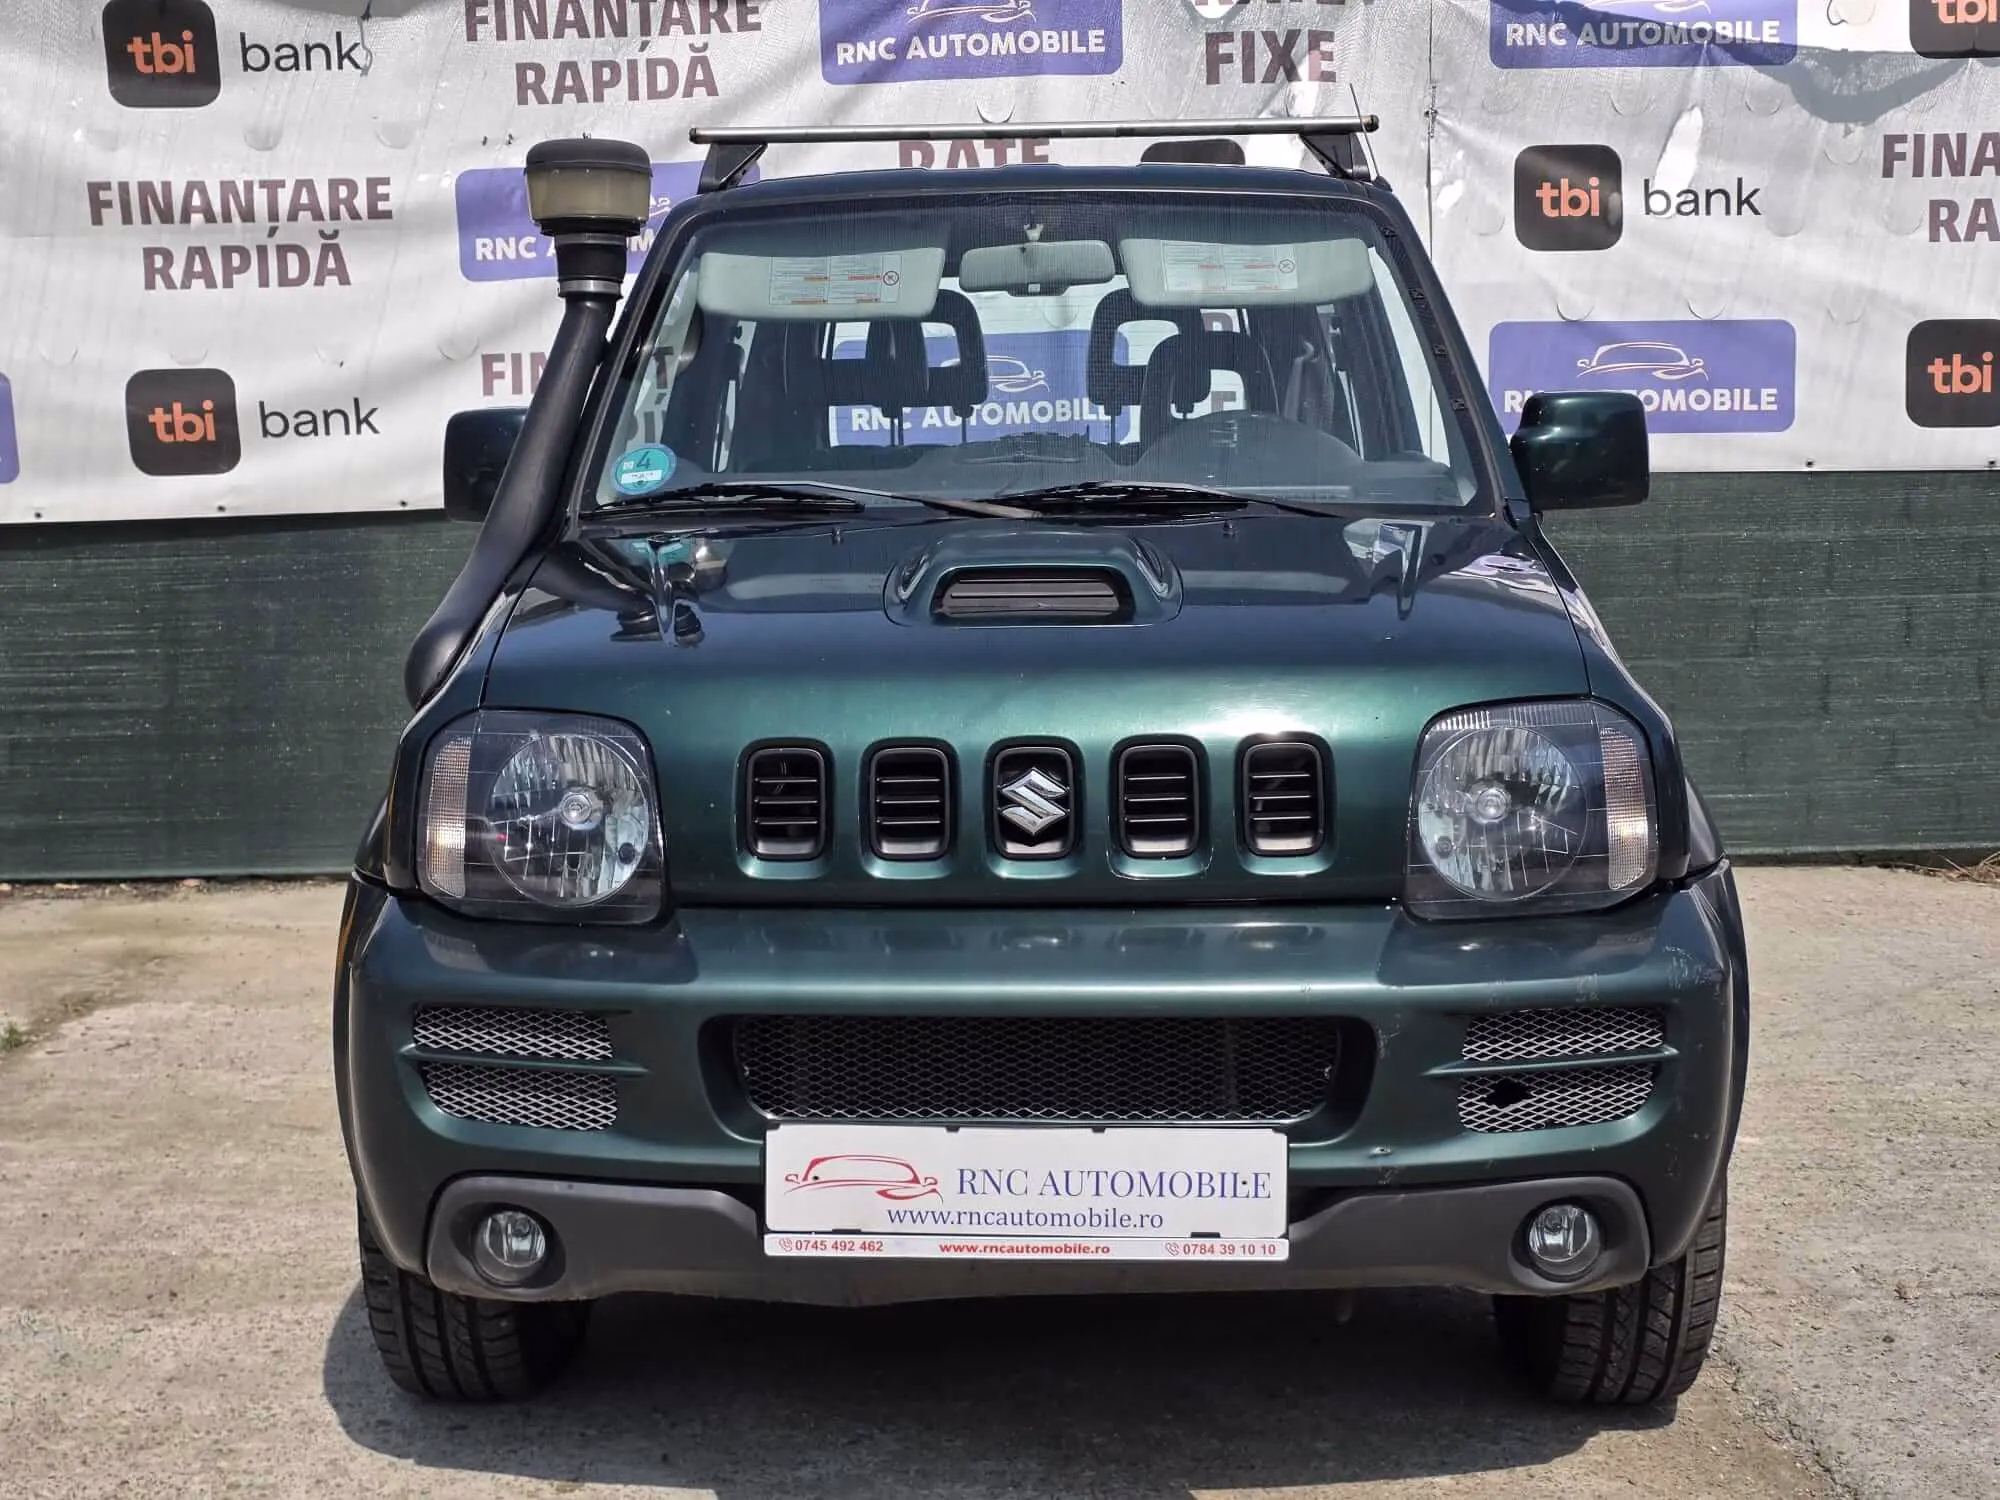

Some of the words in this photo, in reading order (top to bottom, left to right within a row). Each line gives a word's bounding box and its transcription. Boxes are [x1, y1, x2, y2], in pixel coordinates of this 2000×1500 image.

[836, 36, 897, 65] RNC
[905, 29, 1106, 59] AUTOMOBILE
[1505, 22, 1568, 46] RNC
[1576, 20, 1781, 45] AUTOMOBILE
[127, 30, 197, 74] tbi
[239, 31, 362, 72] bank
[1204, 29, 1337, 85] FIXE
[515, 41, 720, 106] RAPIDĂ
[1535, 176, 1601, 217] tbi
[1643, 177, 1762, 217] bank
[142, 229, 352, 290] RAPIDĂ
[474, 236, 537, 261] RNC
[1927, 351, 1994, 394] tbi
[148, 399, 216, 443] tbi
[258, 397, 381, 439] bank
[636, 450, 652, 469] 4
[956, 1168, 1028, 1196] RNC
[1038, 1170, 1272, 1199] AUTOMOBILE
[886, 1208, 1164, 1230] www.rncautomobile.ro
[795, 1239, 828, 1251] 0745
[831, 1240, 856, 1252] 492
[859, 1240, 884, 1252] 462
[938, 1242, 1111, 1255] www.rncautomobile.ro
[1183, 1243, 1215, 1256] 0784
[1219, 1243, 1236, 1256] 39
[1241, 1243, 1257, 1256] 10
[1260, 1243, 1277, 1256] 10
